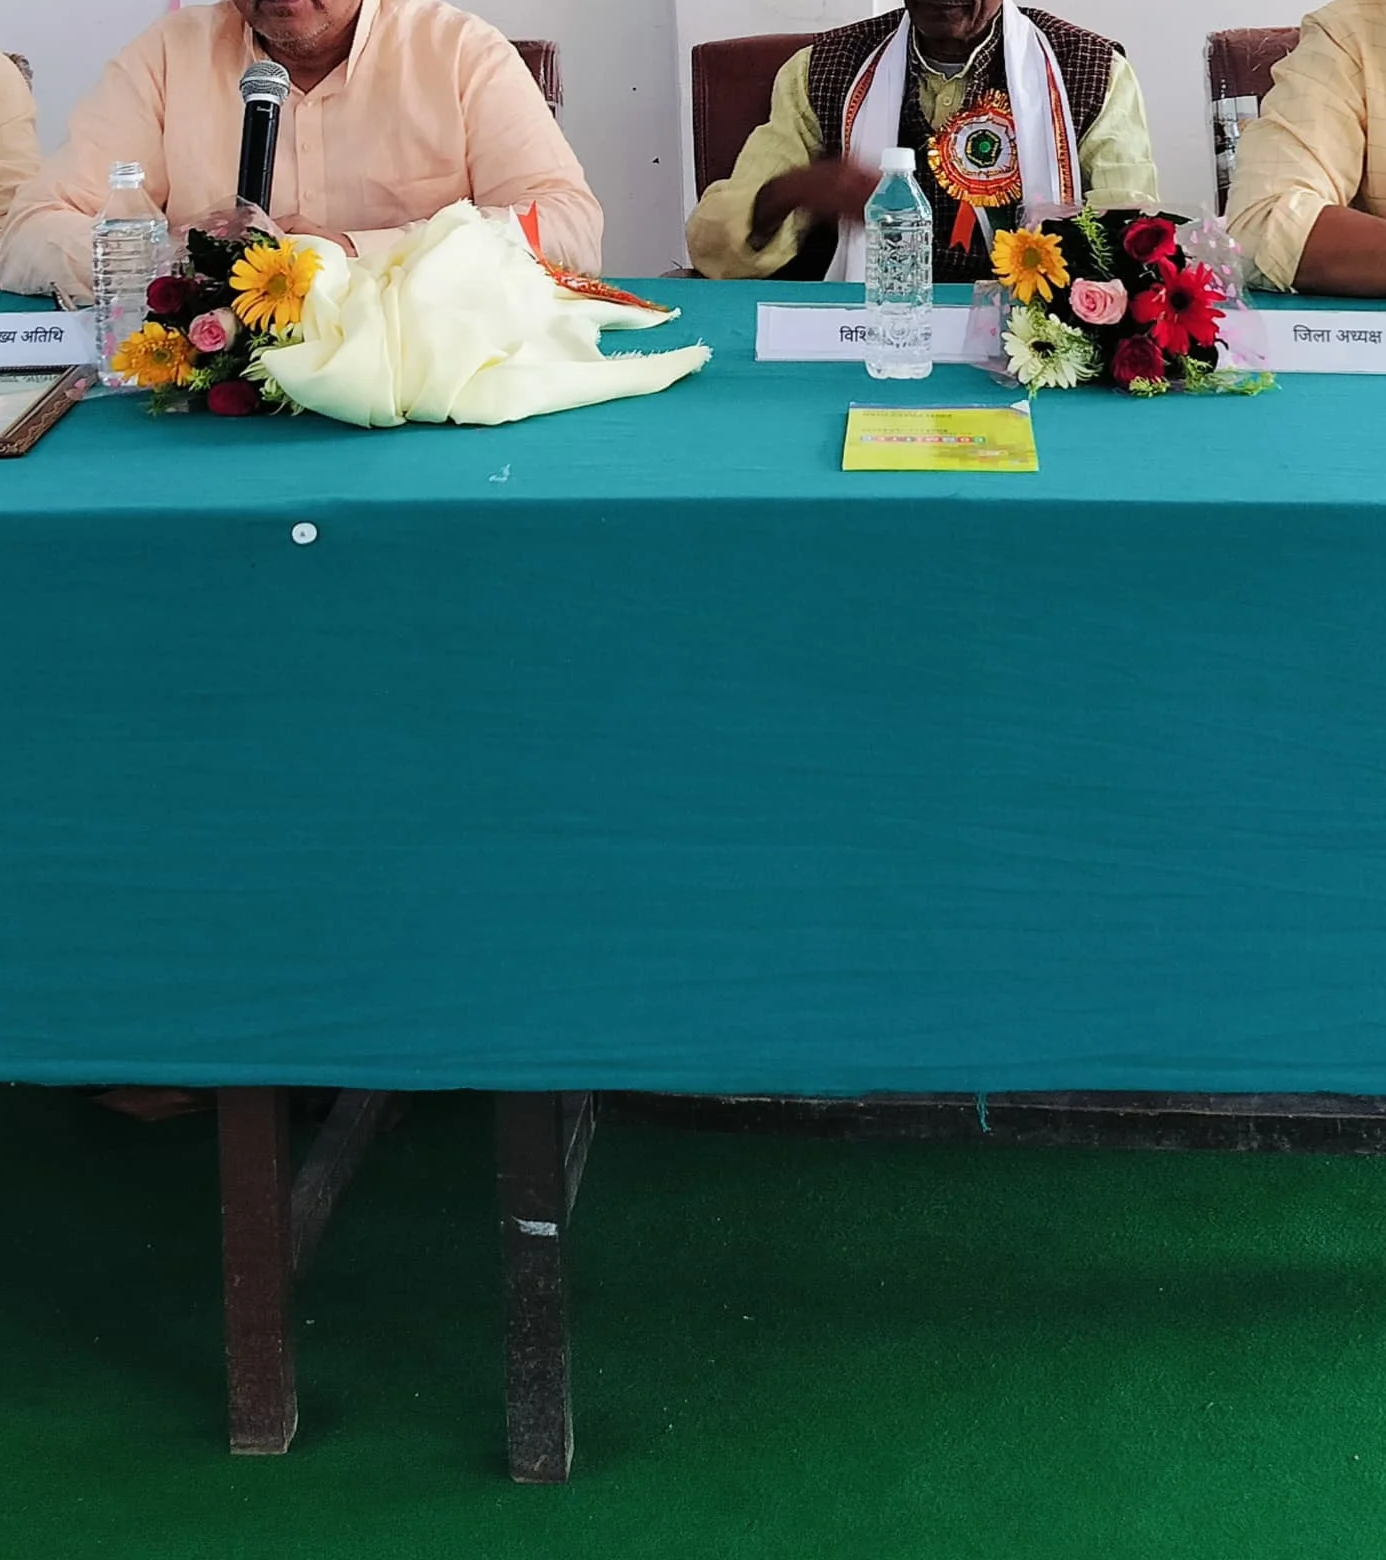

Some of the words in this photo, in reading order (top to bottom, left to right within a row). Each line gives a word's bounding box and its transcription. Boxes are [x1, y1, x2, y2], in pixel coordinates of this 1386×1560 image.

[20, 326, 65, 344] अतिथि
[1292, 324, 1331, 343] जिला
[1335, 328, 1383, 345] अध्यक्ष
